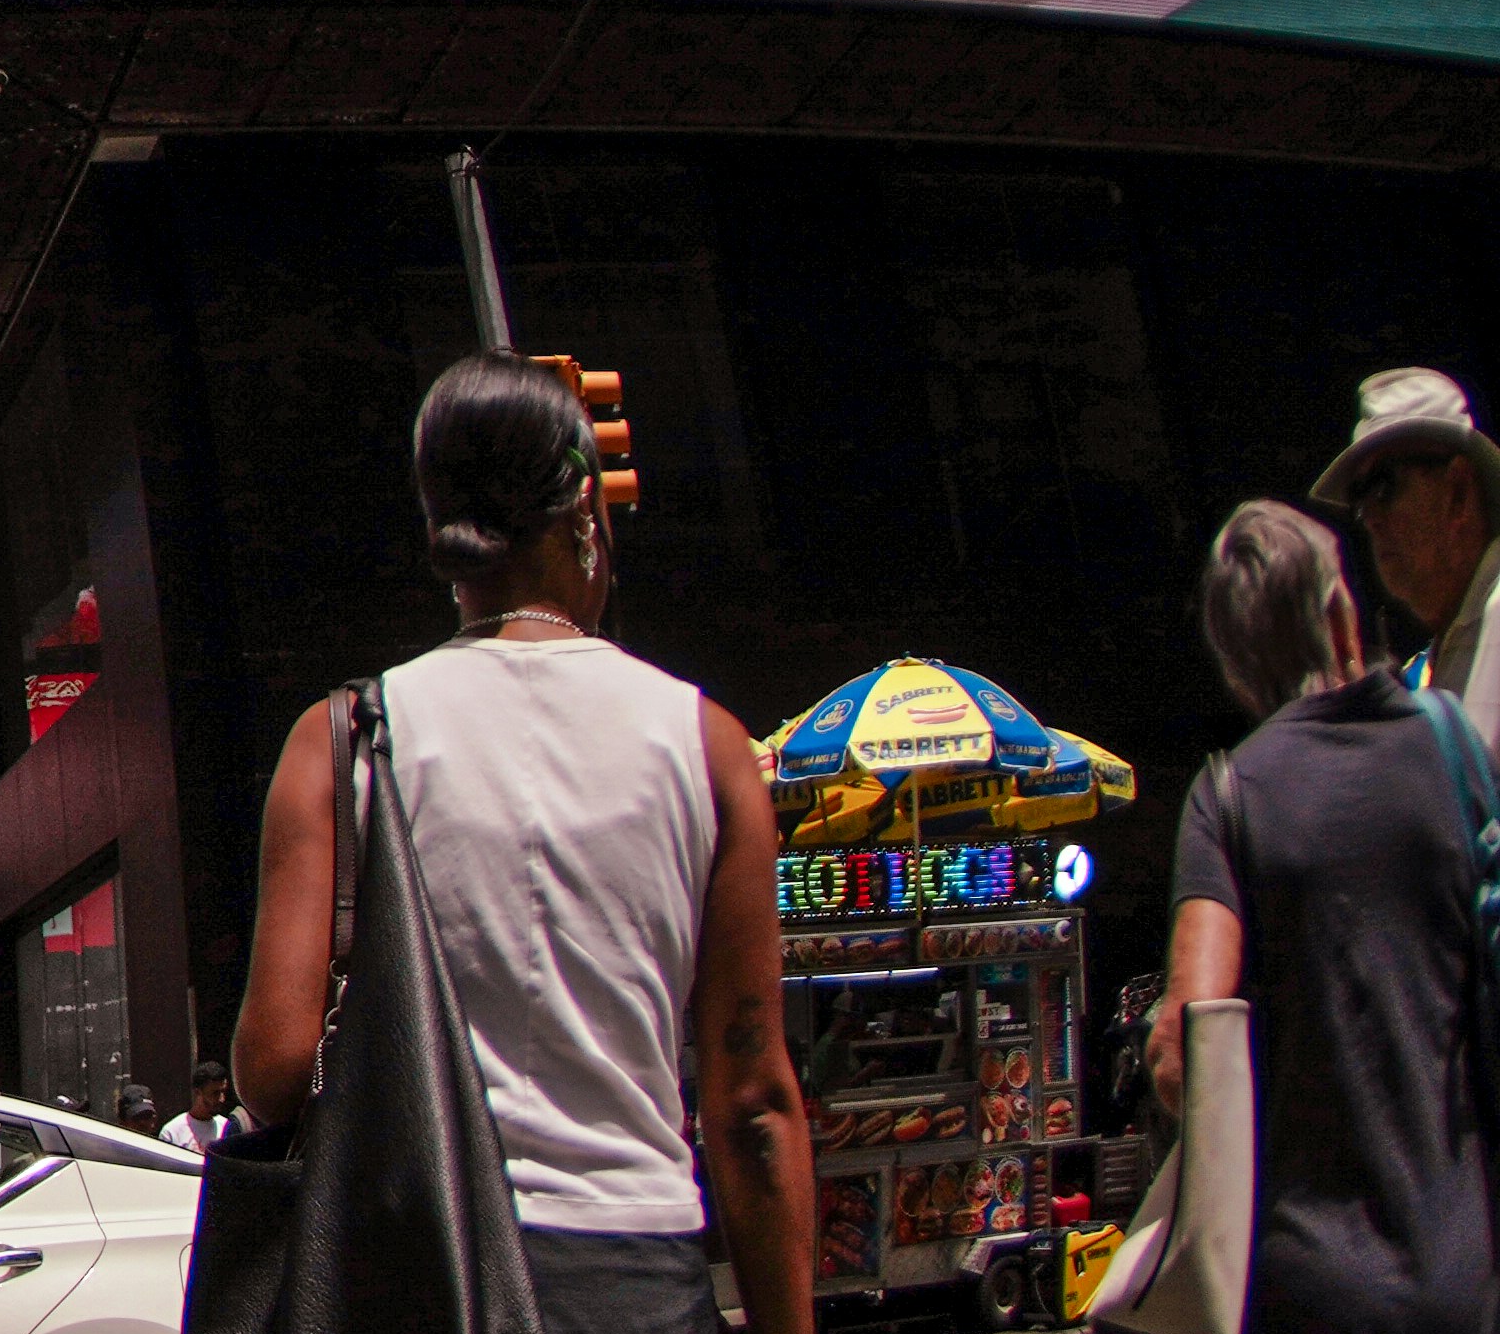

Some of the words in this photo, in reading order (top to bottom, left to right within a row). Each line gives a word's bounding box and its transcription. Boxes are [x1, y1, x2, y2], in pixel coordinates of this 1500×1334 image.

[875, 685, 955, 715] SABRETT
[858, 732, 984, 763] SABRETT
[777, 853, 874, 911] HOT
